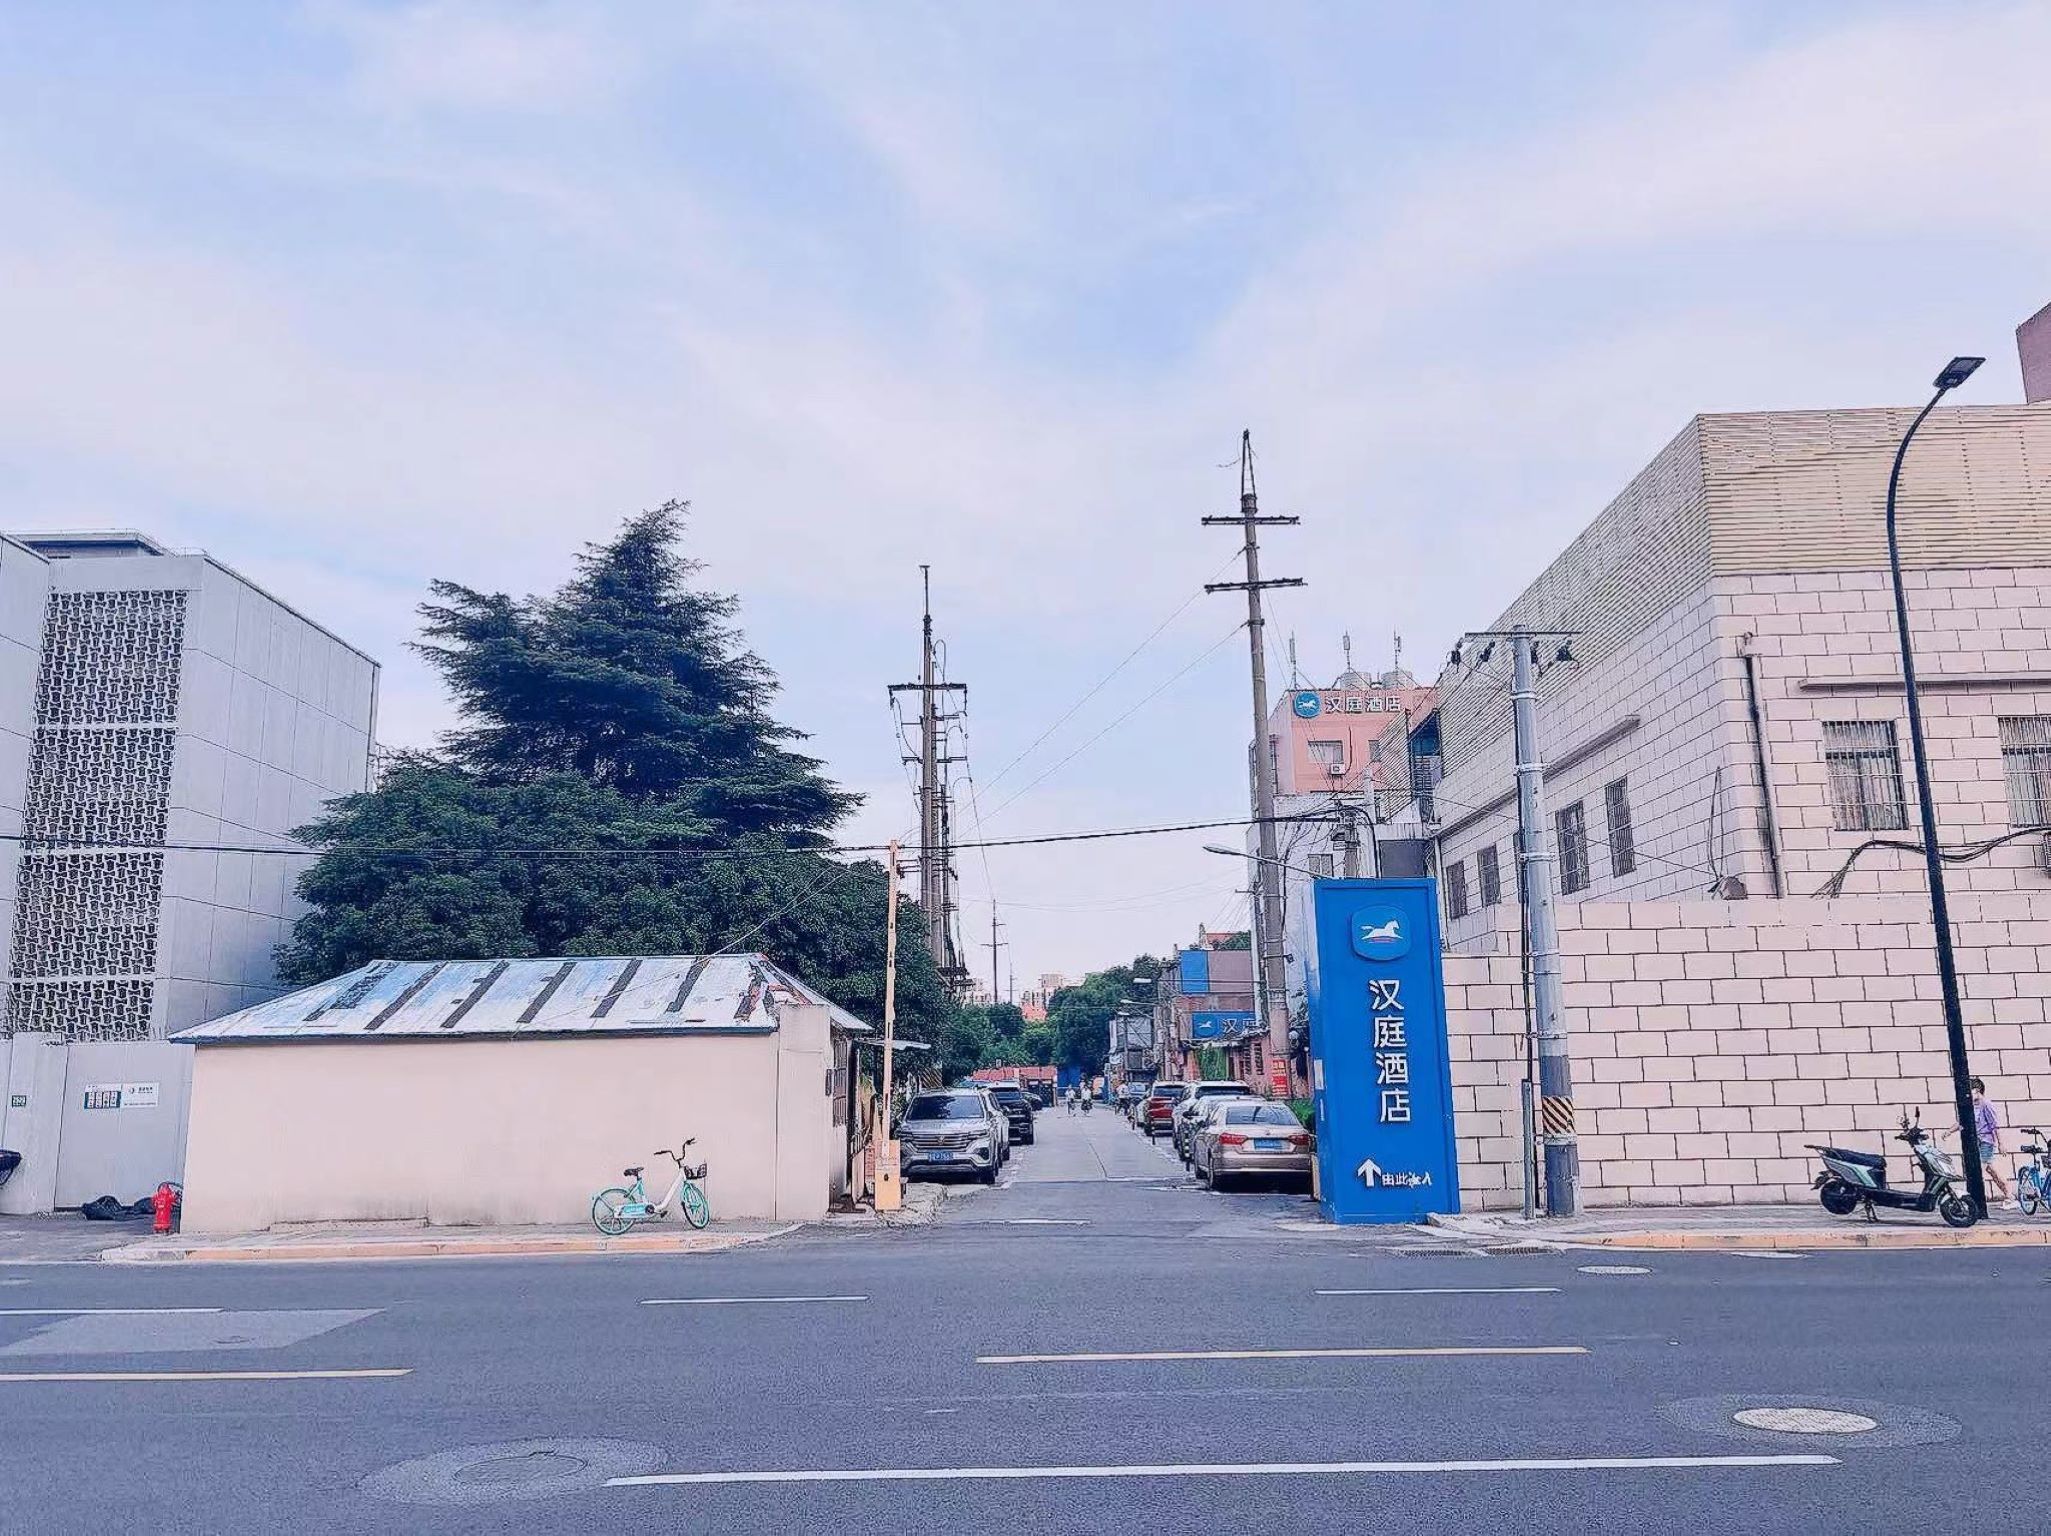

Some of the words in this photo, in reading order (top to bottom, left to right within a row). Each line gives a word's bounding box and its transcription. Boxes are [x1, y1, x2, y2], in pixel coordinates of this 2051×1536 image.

[1325, 696, 1400, 713] 汉庭酒店
[1368, 979, 1411, 1122] 汉庭酒店
